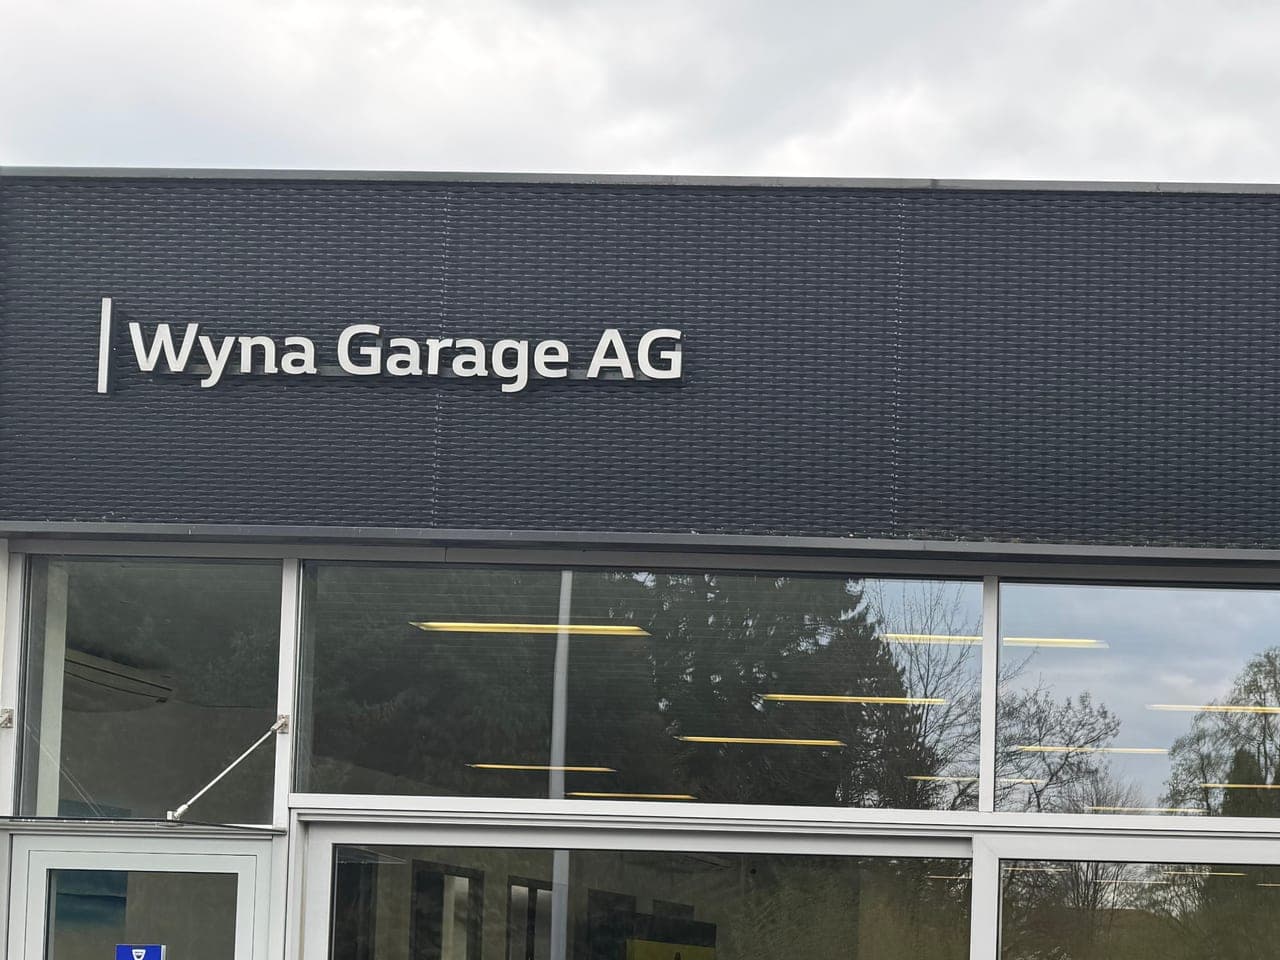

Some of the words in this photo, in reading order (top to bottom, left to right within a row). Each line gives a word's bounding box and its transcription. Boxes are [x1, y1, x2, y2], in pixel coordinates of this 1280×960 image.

[128, 321, 317, 388] Wyna
[337, 324, 568, 393] Garage
[586, 328, 682, 379] AG
